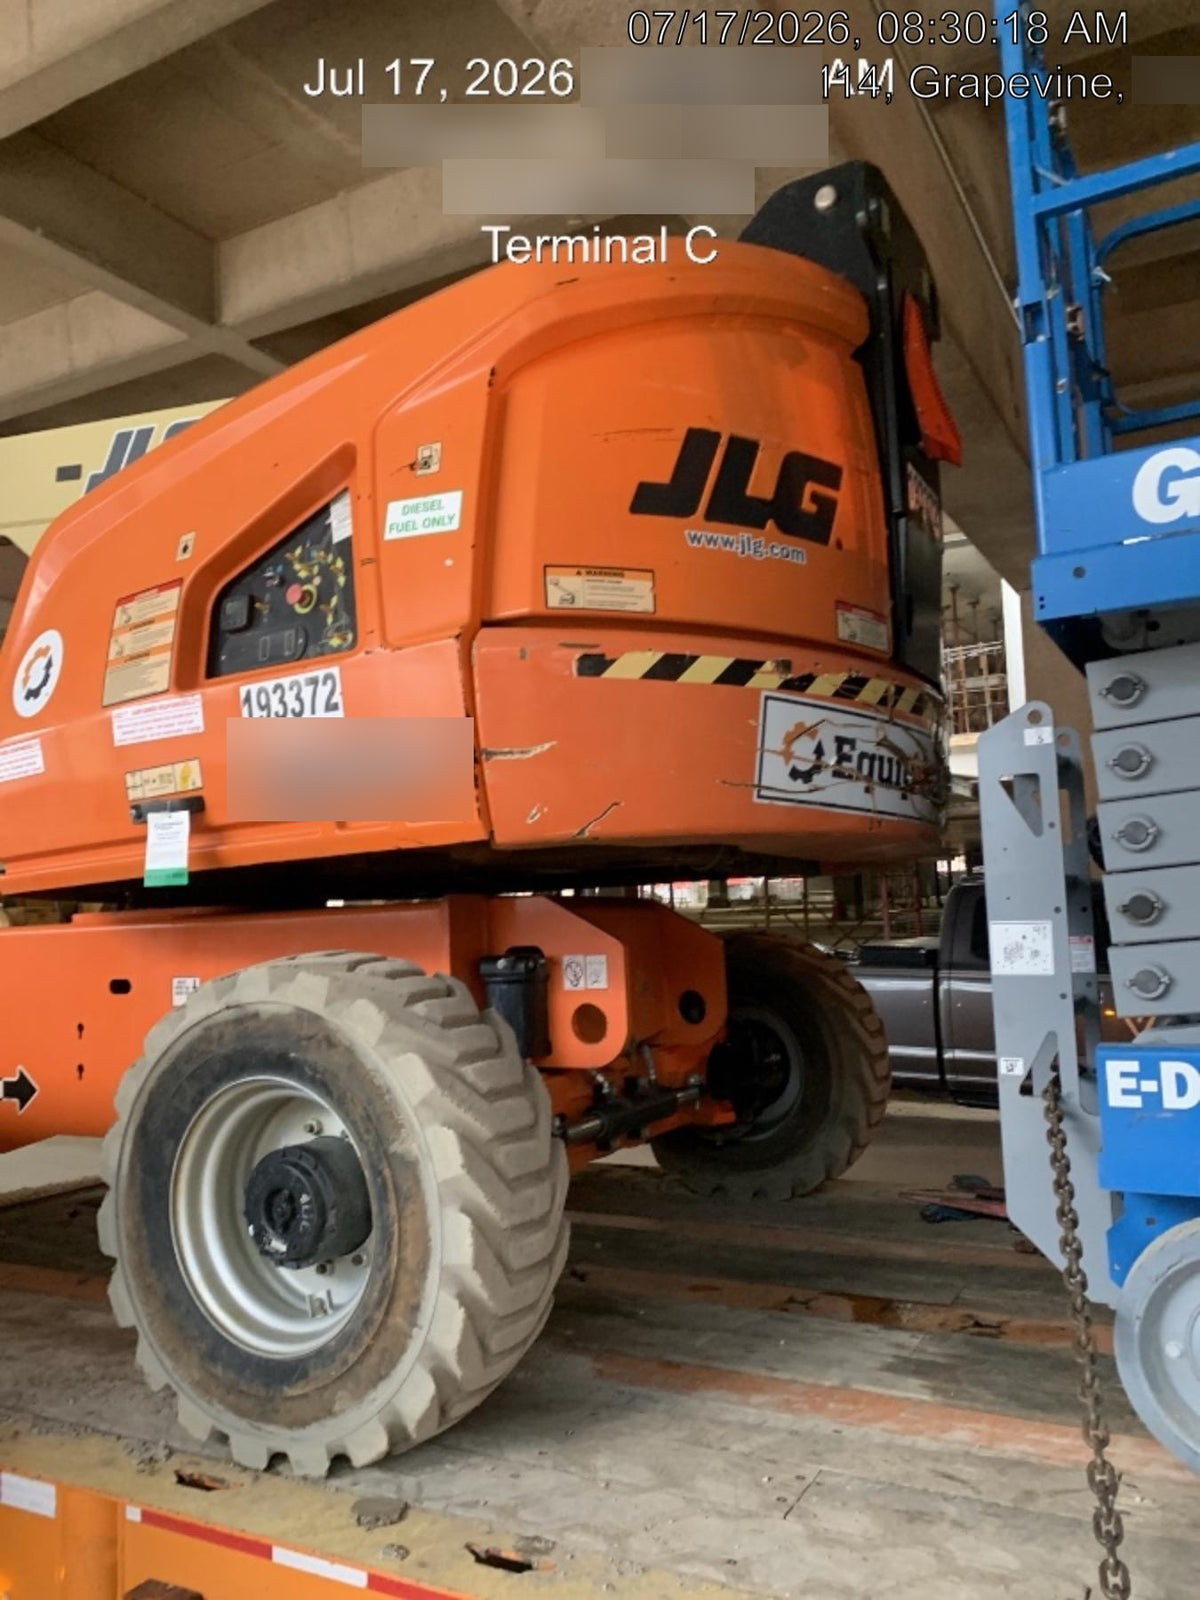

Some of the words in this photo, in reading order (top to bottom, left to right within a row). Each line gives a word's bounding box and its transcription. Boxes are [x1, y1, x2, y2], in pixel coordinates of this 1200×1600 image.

[630, 427, 843, 544] JLG
[401, 499, 445, 516] DIESEL
[388, 519, 419, 535] FUEL
[422, 512, 456, 529] ONLY
[686, 530, 807, 564] www.jlg.com
